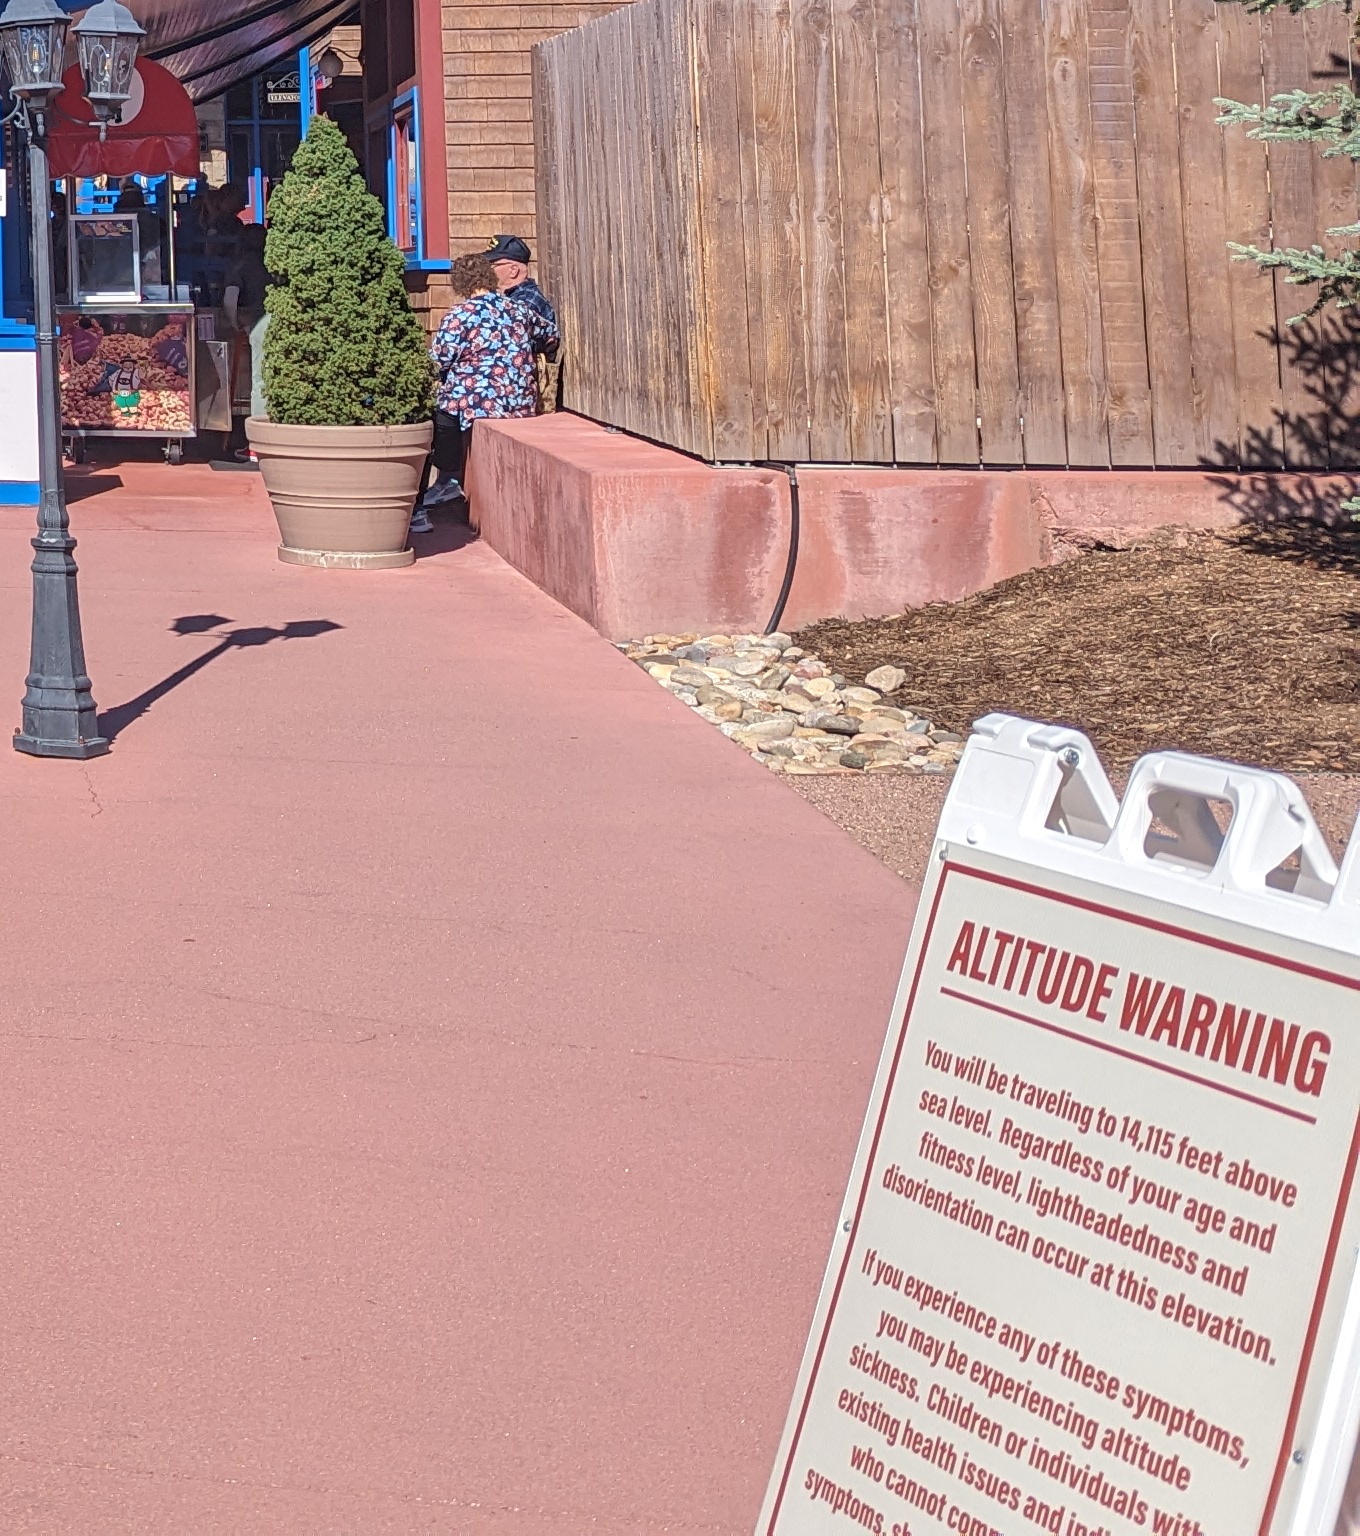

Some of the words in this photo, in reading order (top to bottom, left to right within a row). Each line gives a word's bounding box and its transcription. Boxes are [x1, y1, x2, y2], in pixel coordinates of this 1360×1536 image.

[945, 918, 1121, 1024] ALTITUDE
[1118, 971, 1333, 1098] WARNING
[917, 1089, 949, 1119] sea
[947, 1096, 993, 1138] level.
[997, 1116, 1105, 1184] Regardless
[1105, 1164, 1132, 1194] of
[1126, 1176, 1183, 1215] your
[1181, 1196, 1228, 1235] age
[1227, 1215, 1278, 1254] and
[925, 1039, 954, 1074] You
[953, 1055, 986, 1086] will
[983, 1064, 1010, 1095] be
[1008, 1074, 1095, 1135] traveling
[1094, 1107, 1119, 1139] to
[1118, 1115, 1175, 1161] 14,115
[1175, 1135, 1225, 1180] feet
[1223, 1159, 1299, 1209] above
[881, 1162, 995, 1236] disorientation
[993, 1219, 1031, 1252] can
[1030, 1235, 1090, 1277] occur
[1088, 1262, 1116, 1292] at
[1114, 1268, 1159, 1312] this
[1159, 1293, 1276, 1365] elevation.
[918, 1130, 976, 1179] fitness
[974, 1155, 1022, 1202] level,
[1025, 1176, 1200, 1276] lightheadedness
[1200, 1257, 1250, 1297] and
[848, 1344, 921, 1403] sickness.
[925, 1382, 1003, 1448] Children
[1003, 1430, 1030, 1458] or
[1027, 1442, 1149, 1527] individuals
[861, 1249, 878, 1274] If
[871, 1260, 905, 1292] you
[902, 1274, 999, 1340] experience
[997, 1322, 1036, 1364] any
[1035, 1340, 1062, 1370] of
[1059, 1348, 1122, 1402] these
[1120, 1383, 1250, 1469] symptoms,
[875, 1310, 910, 1344] you
[906, 1326, 946, 1368] may
[943, 1342, 970, 1377] be
[968, 1359, 1101, 1452] experiencing
[1099, 1426, 1192, 1493] altitude
[836, 1387, 902, 1448] existing
[899, 1420, 959, 1474] health
[957, 1451, 1023, 1512] issues
[1021, 1494, 1067, 1536] and
[849, 1445, 886, 1484] who
[884, 1467, 949, 1522] cannot
